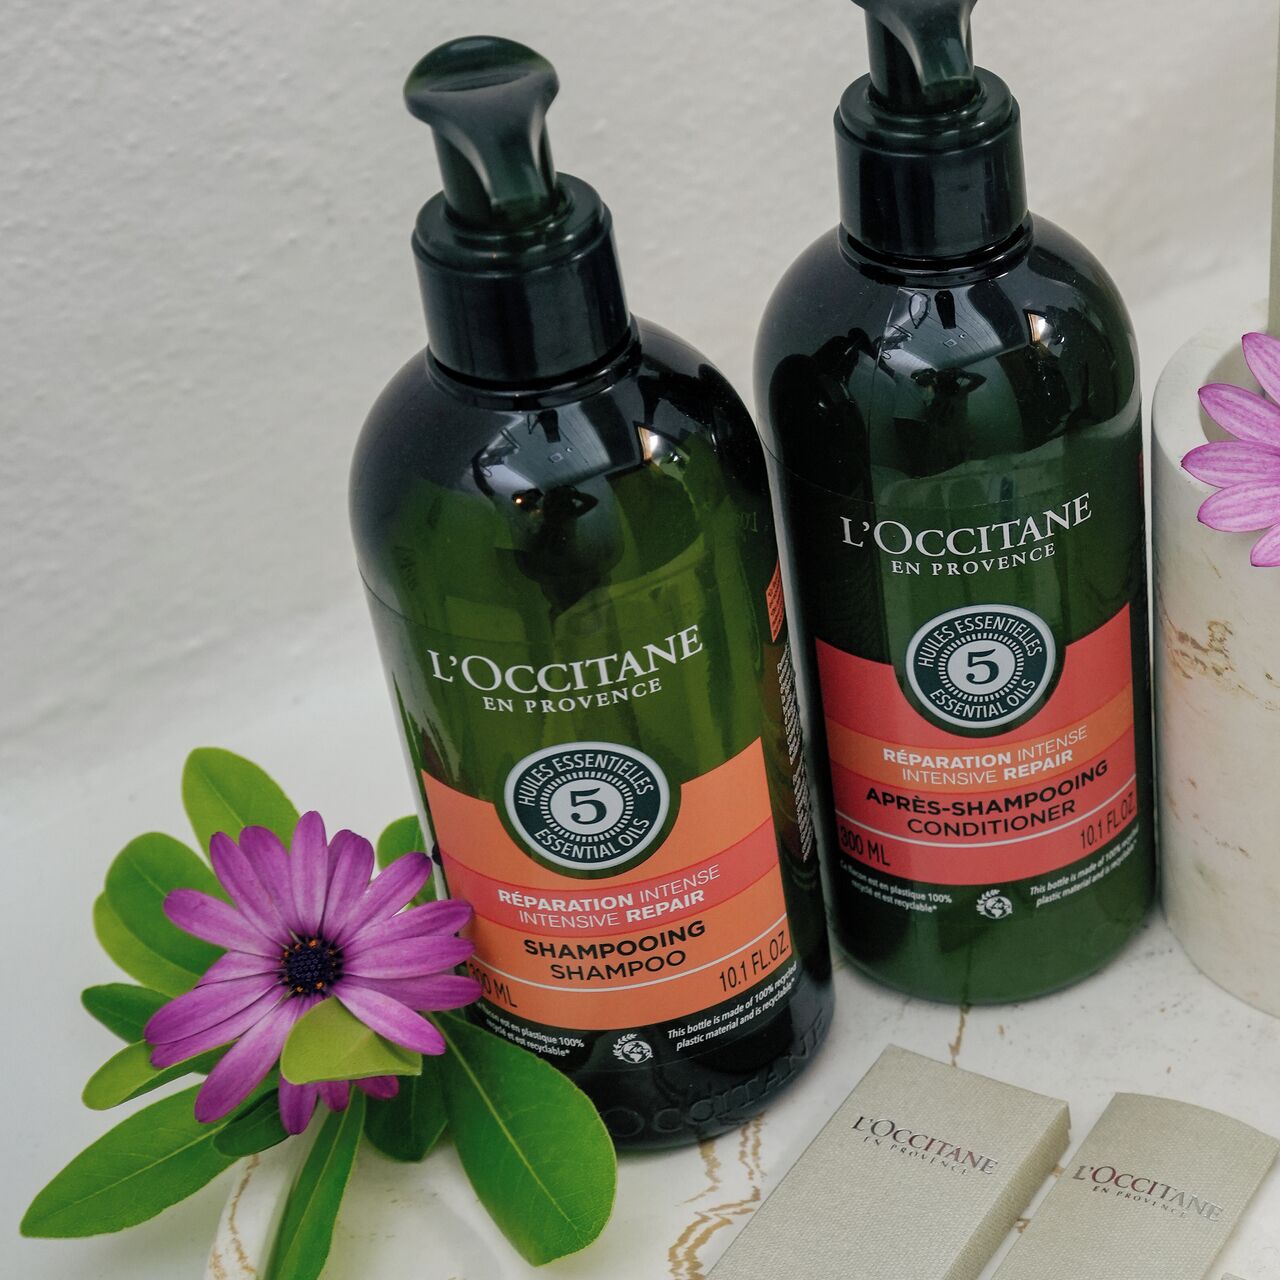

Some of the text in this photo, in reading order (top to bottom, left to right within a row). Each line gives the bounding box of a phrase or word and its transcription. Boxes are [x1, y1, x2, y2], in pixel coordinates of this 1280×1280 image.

[840, 492, 1092, 557] L'OCCITANE
[891, 543, 1056, 576] EN PROVENCE
[427, 624, 703, 694] L'OCCITANE
[918, 616, 1043, 667] HUILES ESSENTIELLES
[965, 649, 999, 685] 5
[482, 678, 662, 713] EN PROVENCE
[930, 678, 1035, 718] ESSENTIAL OILS
[883, 725, 1088, 770] RÉPARATION INTENSE
[903, 749, 1073, 785] INTENSIVE REPAIR
[518, 753, 654, 807] HUILES ESSENTIELLES
[866, 760, 1107, 817] APRÈS-SHAMPOOING
[570, 787, 608, 825] 5
[907, 799, 1075, 837] CONDITIONER
[534, 818, 650, 859] ESSENTIAL OILS
[840, 826, 890, 866] 300 ML
[497, 864, 721, 912] RÉPARATION INTENSE
[519, 889, 705, 928] INTENSIVE REPAIR
[523, 920, 706, 960] SHAMPOOING
[550, 950, 686, 981] SHAMPOO
[719, 960, 748, 992] 10.1
[493, 978, 518, 1008] ML
[667, 1029, 686, 1040] This
[686, 1018, 712, 1034] bottle
[713, 1015, 721, 1025] is
[721, 1004, 744, 1022] made
[745, 997, 755, 1010] of
[755, 985, 774, 1004] 100%
[558, 1036, 585, 1048] 100%
[676, 1034, 705, 1051] plastic
[705, 1018, 739, 1042] material
[739, 1009, 755, 1026] and
[755, 1006, 762, 1017] is
[851, 1116, 998, 1175] L'OCCITANE
[1072, 1165, 1224, 1223] L'OCCITANE
